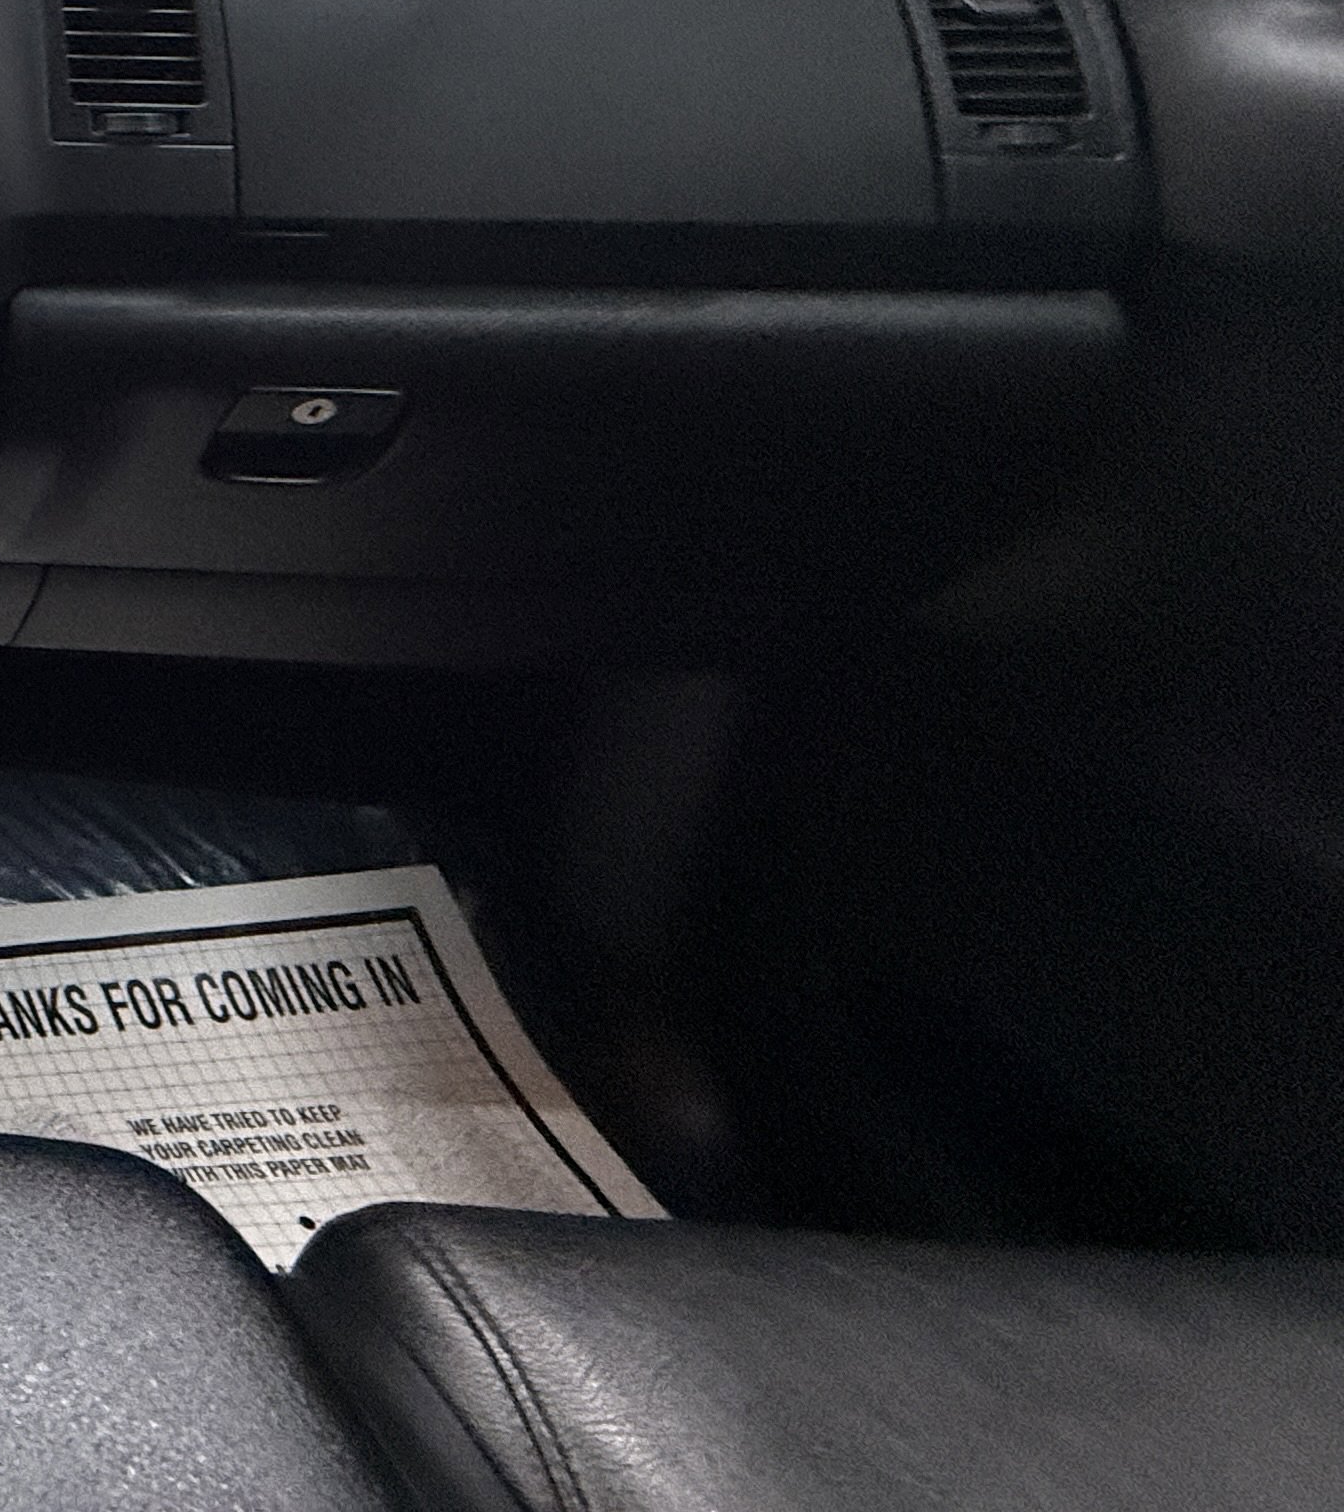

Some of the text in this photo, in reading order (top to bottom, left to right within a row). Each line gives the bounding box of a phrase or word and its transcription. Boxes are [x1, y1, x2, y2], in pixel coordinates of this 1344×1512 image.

[100, 977, 194, 1031] FOR
[194, 961, 367, 1023] COMING
[364, 955, 422, 1006] IN
[127, 1104, 342, 1136] WE HAVE TRIED TO KEEP
[139, 1128, 366, 1160] YOUR CARPETING CLEAN
[220, 1161, 268, 1181] THIS
[265, 1156, 331, 1178] PAPER
[326, 1153, 372, 1172] MAT
